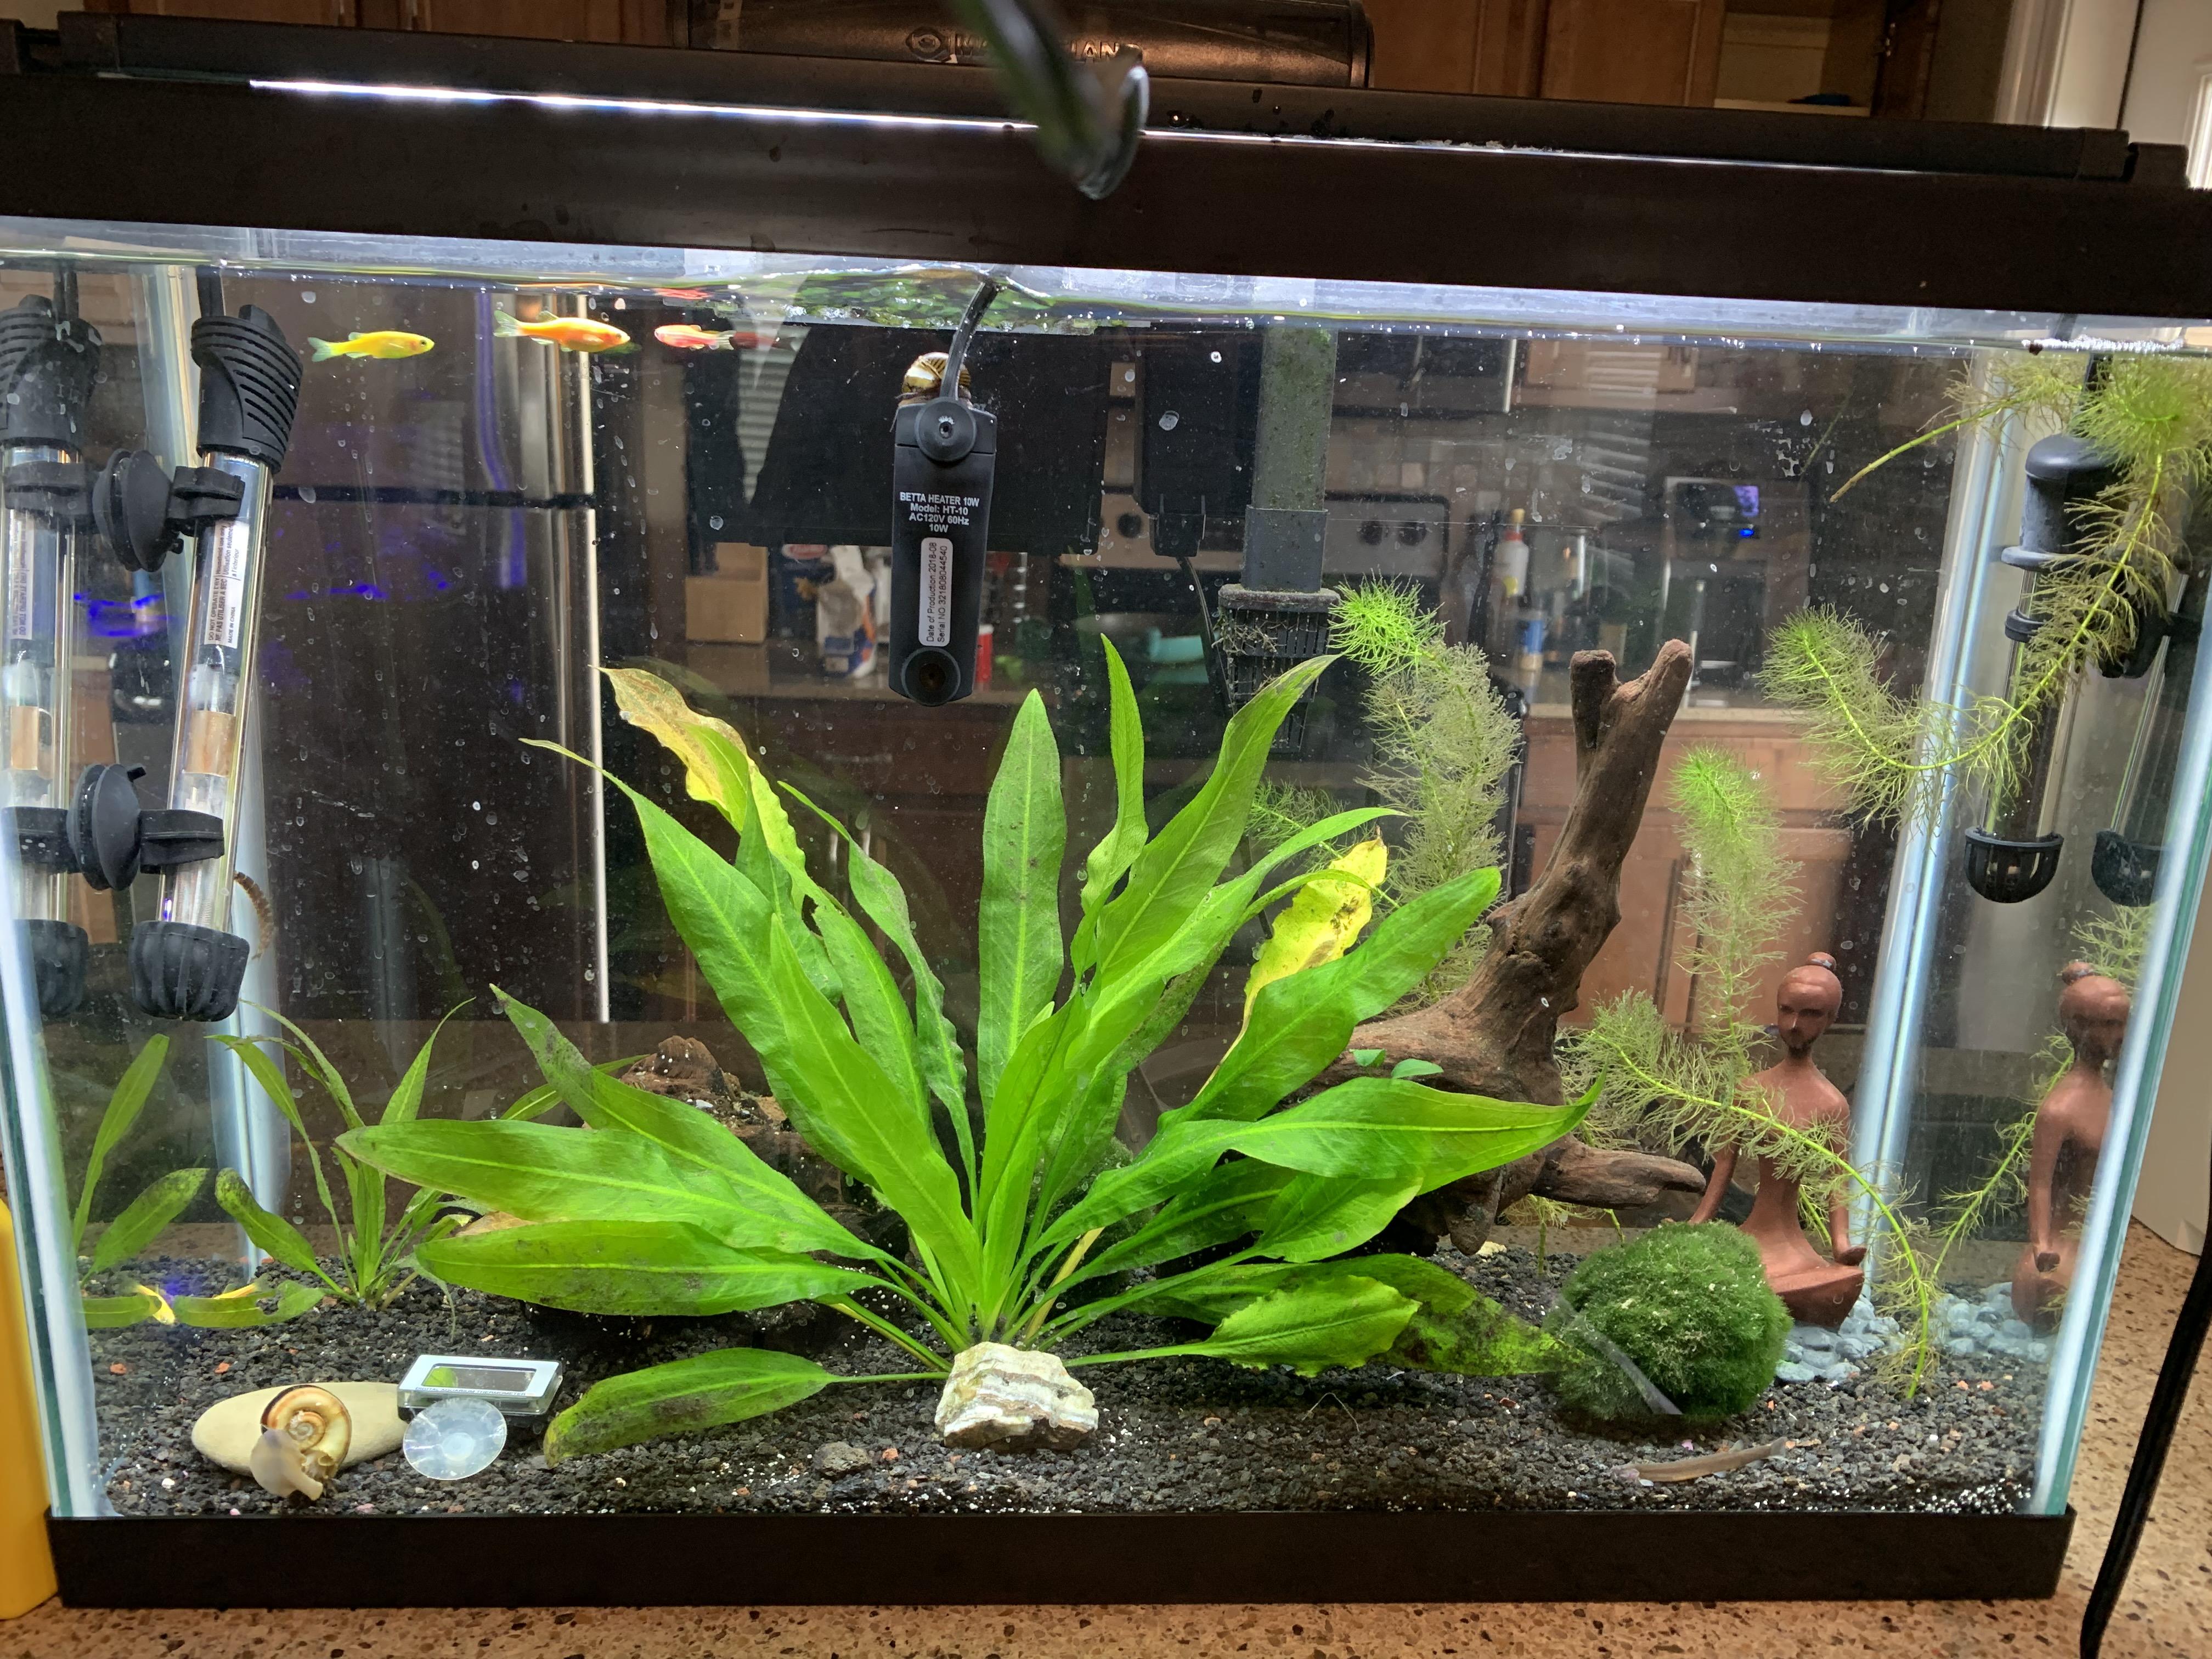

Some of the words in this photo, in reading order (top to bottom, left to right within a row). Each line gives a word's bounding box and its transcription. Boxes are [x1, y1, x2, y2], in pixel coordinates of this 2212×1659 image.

[900, 492, 927, 503] BETTA
[928, 494, 961, 505] HEATER
[963, 497, 980, 507] 10W
[910, 503, 940, 513] Model:
[943, 505, 968, 515] HT-10
[909, 512, 945, 523] AC120V
[947, 515, 969, 525] 60Hz
[929, 523, 949, 533] 10W
[217, 596, 225, 620] UTILISER
[208, 632, 215, 640] DO
[926, 625, 935, 642] Date
